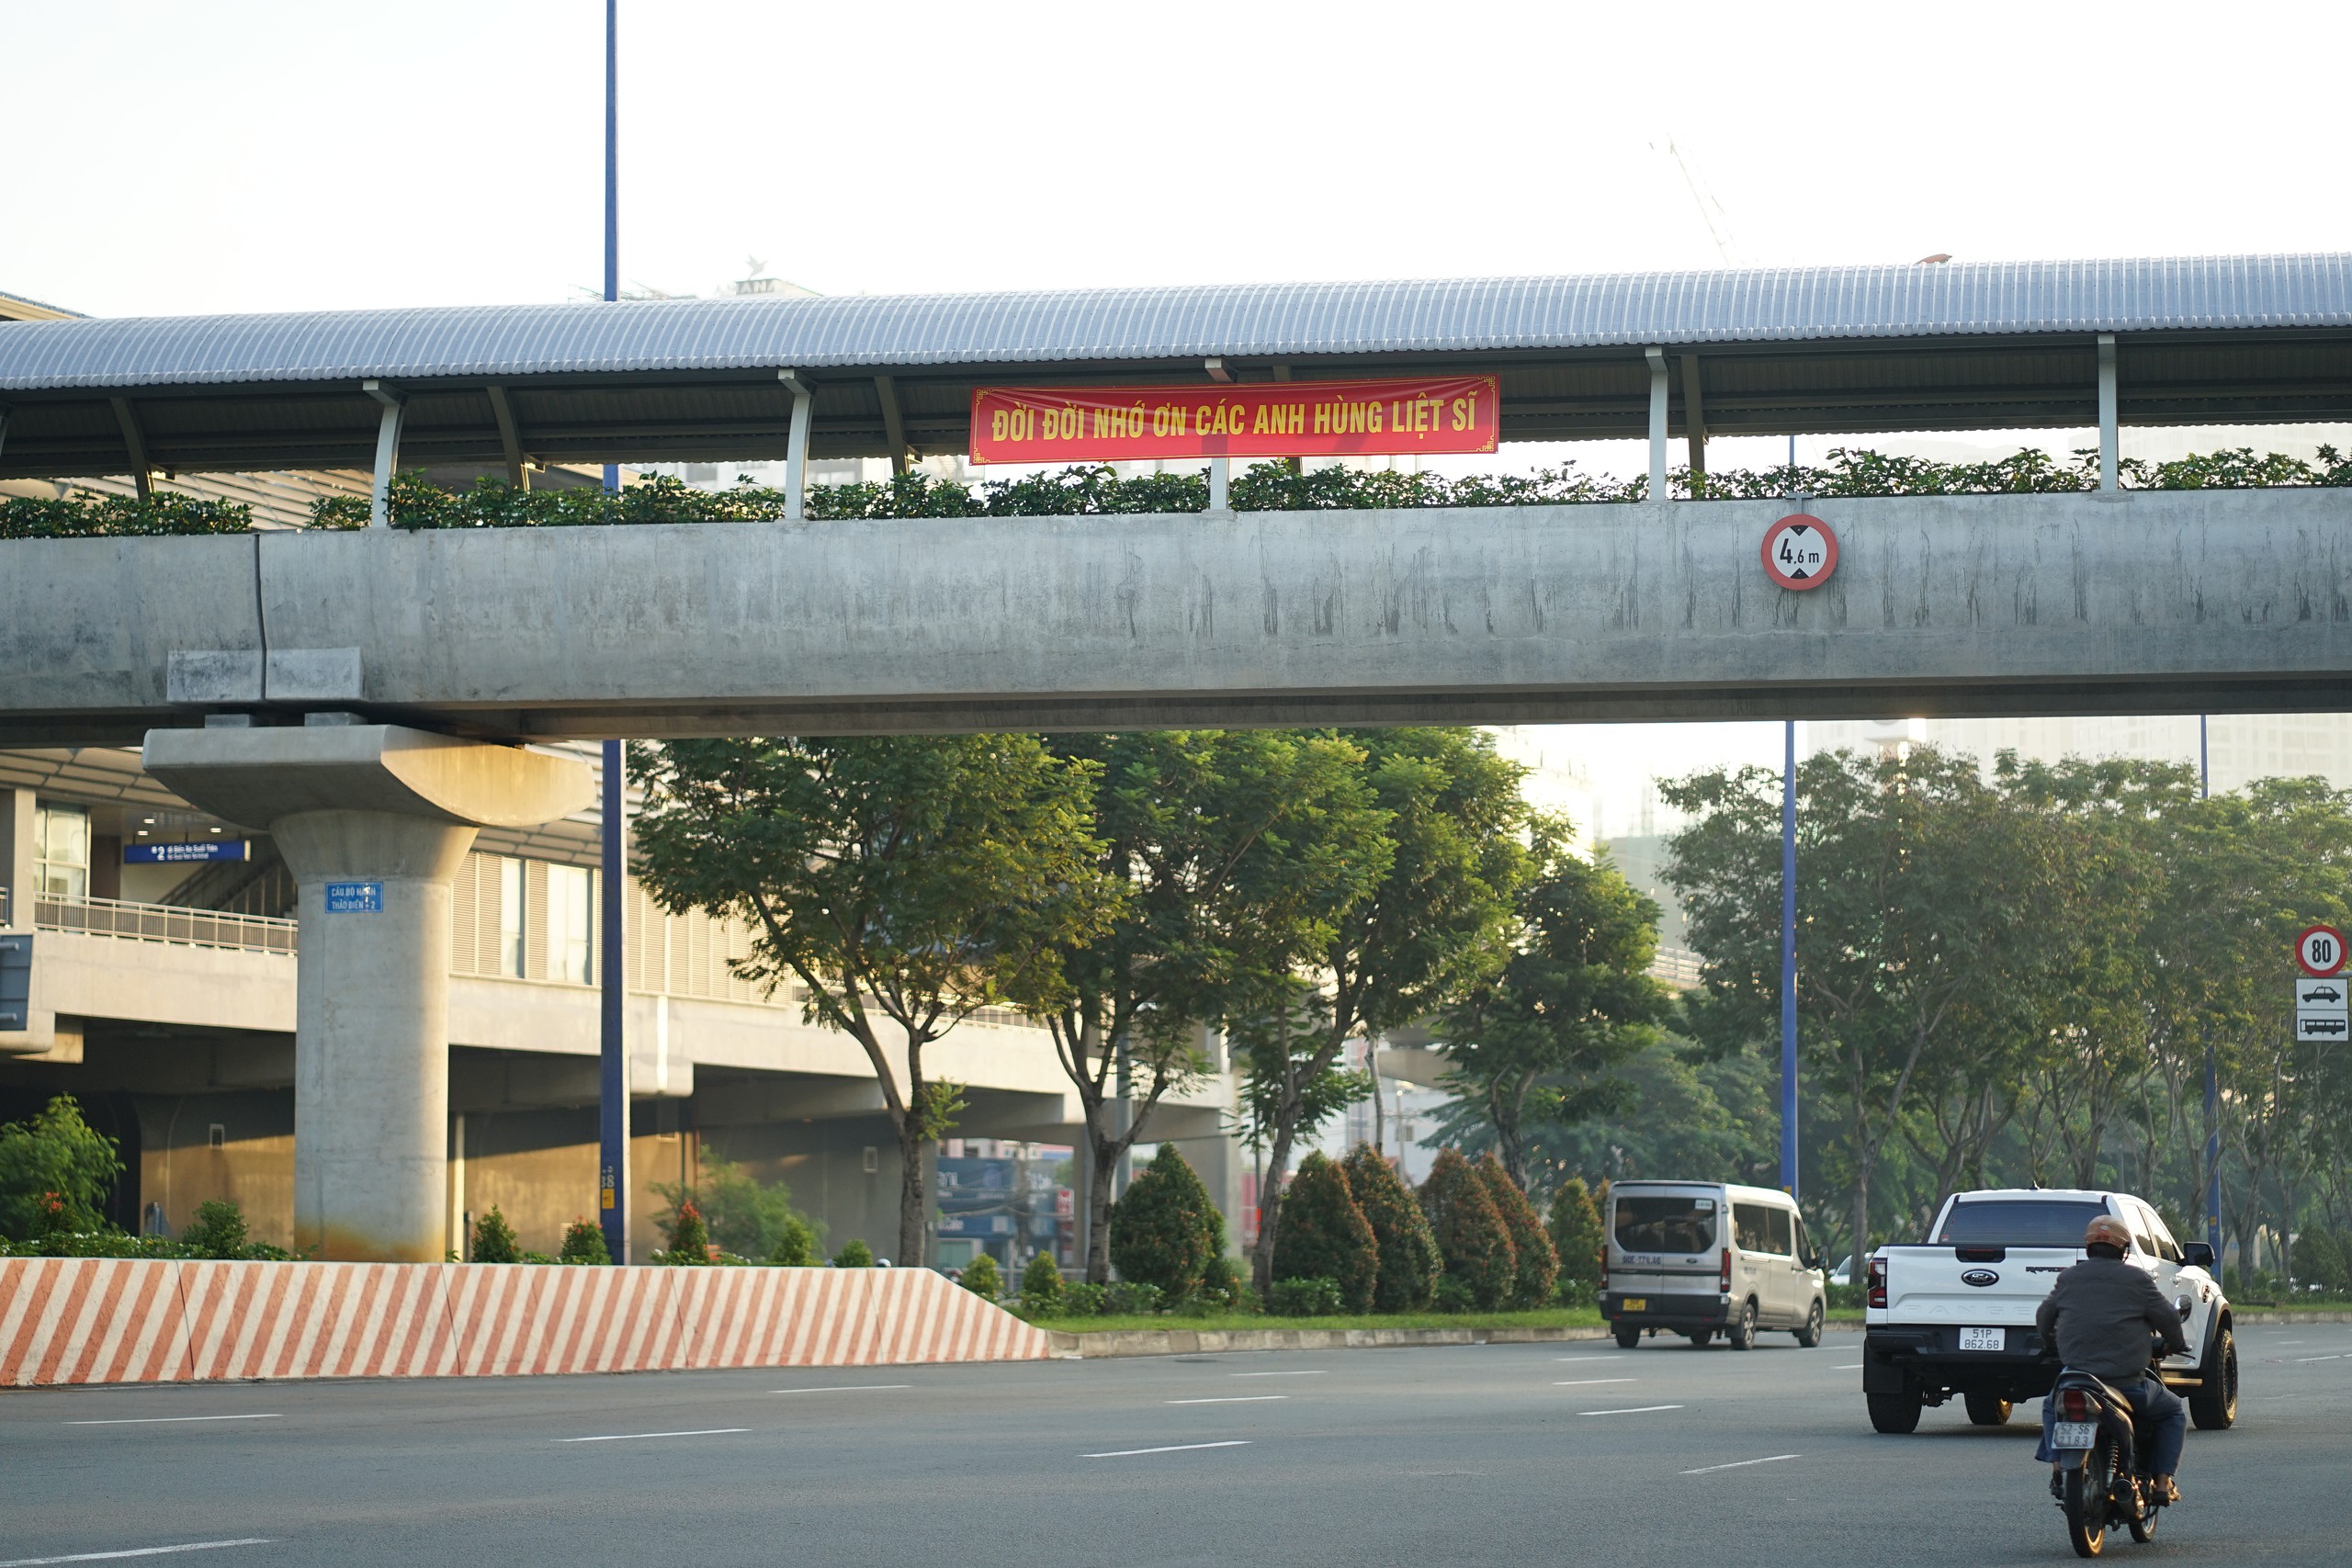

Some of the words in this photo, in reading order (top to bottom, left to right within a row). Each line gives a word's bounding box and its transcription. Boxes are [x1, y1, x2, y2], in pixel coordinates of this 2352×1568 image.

[992, 401, 1034, 442] ĐỜI
[1042, 400, 1085, 441] ĐỜI
[1093, 400, 1146, 439] NHỚ
[1153, 402, 1187, 437] ƠN
[1195, 398, 1245, 435] CÁC
[1253, 403, 1305, 434] ANH
[1314, 395, 1383, 434] HÙNG
[1392, 391, 1444, 439] LIỆT
[1452, 390, 1477, 431] SĨ
[1780, 538, 1804, 565] 4,6
[1808, 552, 1819, 563] m
[370, 901, 376, 909] 2
[2312, 939, 2331, 963] 80
[1973, 1328, 1992, 1338] 51P
[1964, 1339, 1999, 1349] 862.68
[2060, 1424, 2090, 1435] 52-S6
